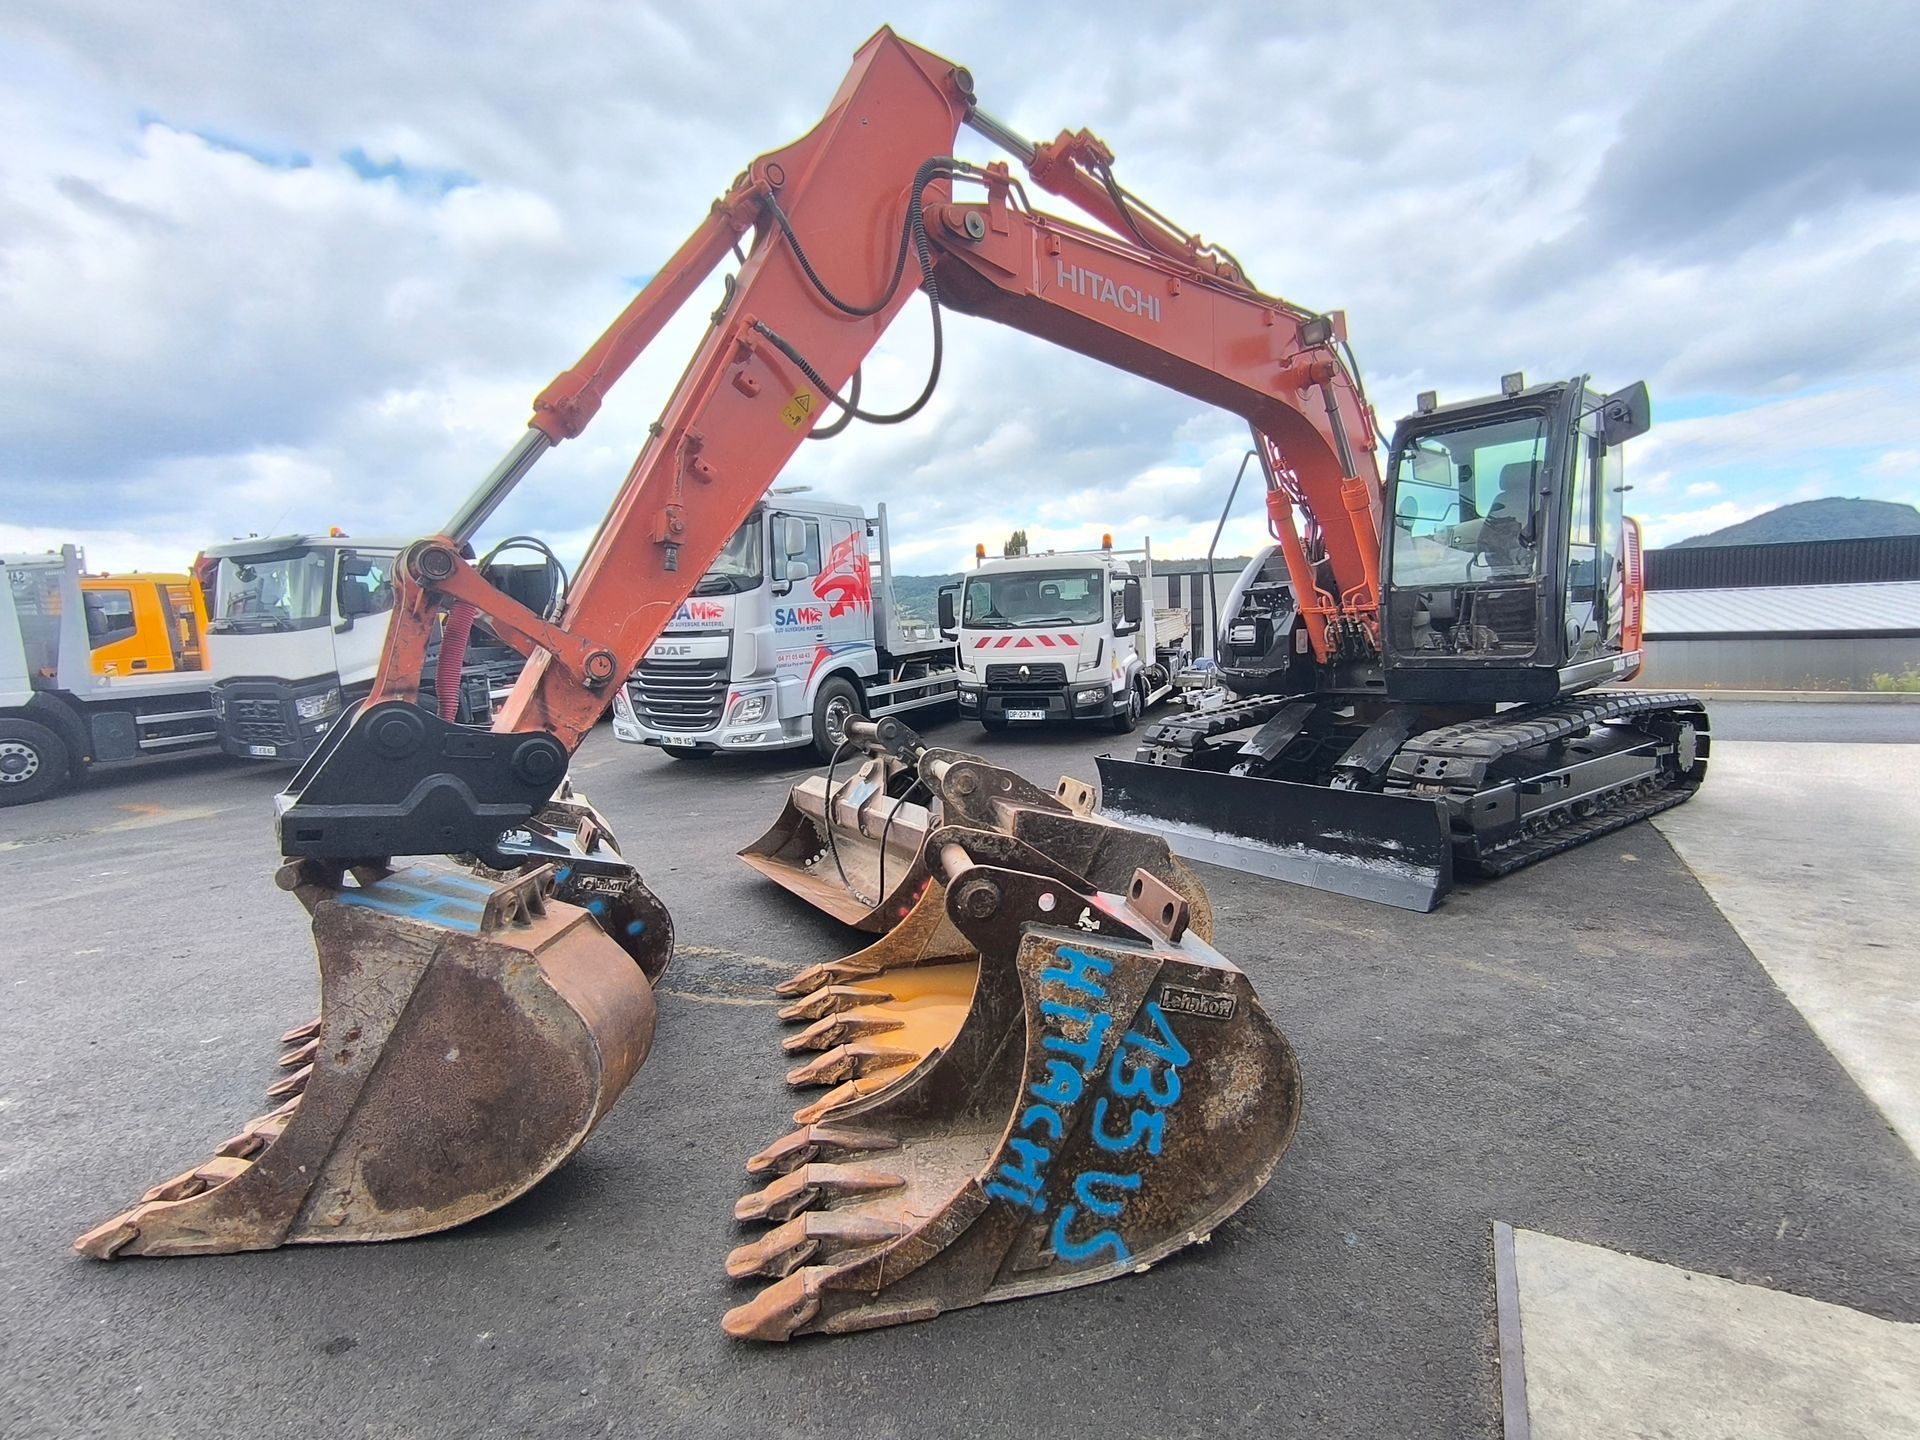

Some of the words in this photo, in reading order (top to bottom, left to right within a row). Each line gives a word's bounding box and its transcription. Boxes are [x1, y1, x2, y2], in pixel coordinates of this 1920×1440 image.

[1057, 259, 1160, 322] HITACHI
[669, 603, 706, 620] AM
[775, 607, 810, 626] SAM
[654, 646, 691, 655] DAF
[987, 945, 1114, 1214] HITACHI
